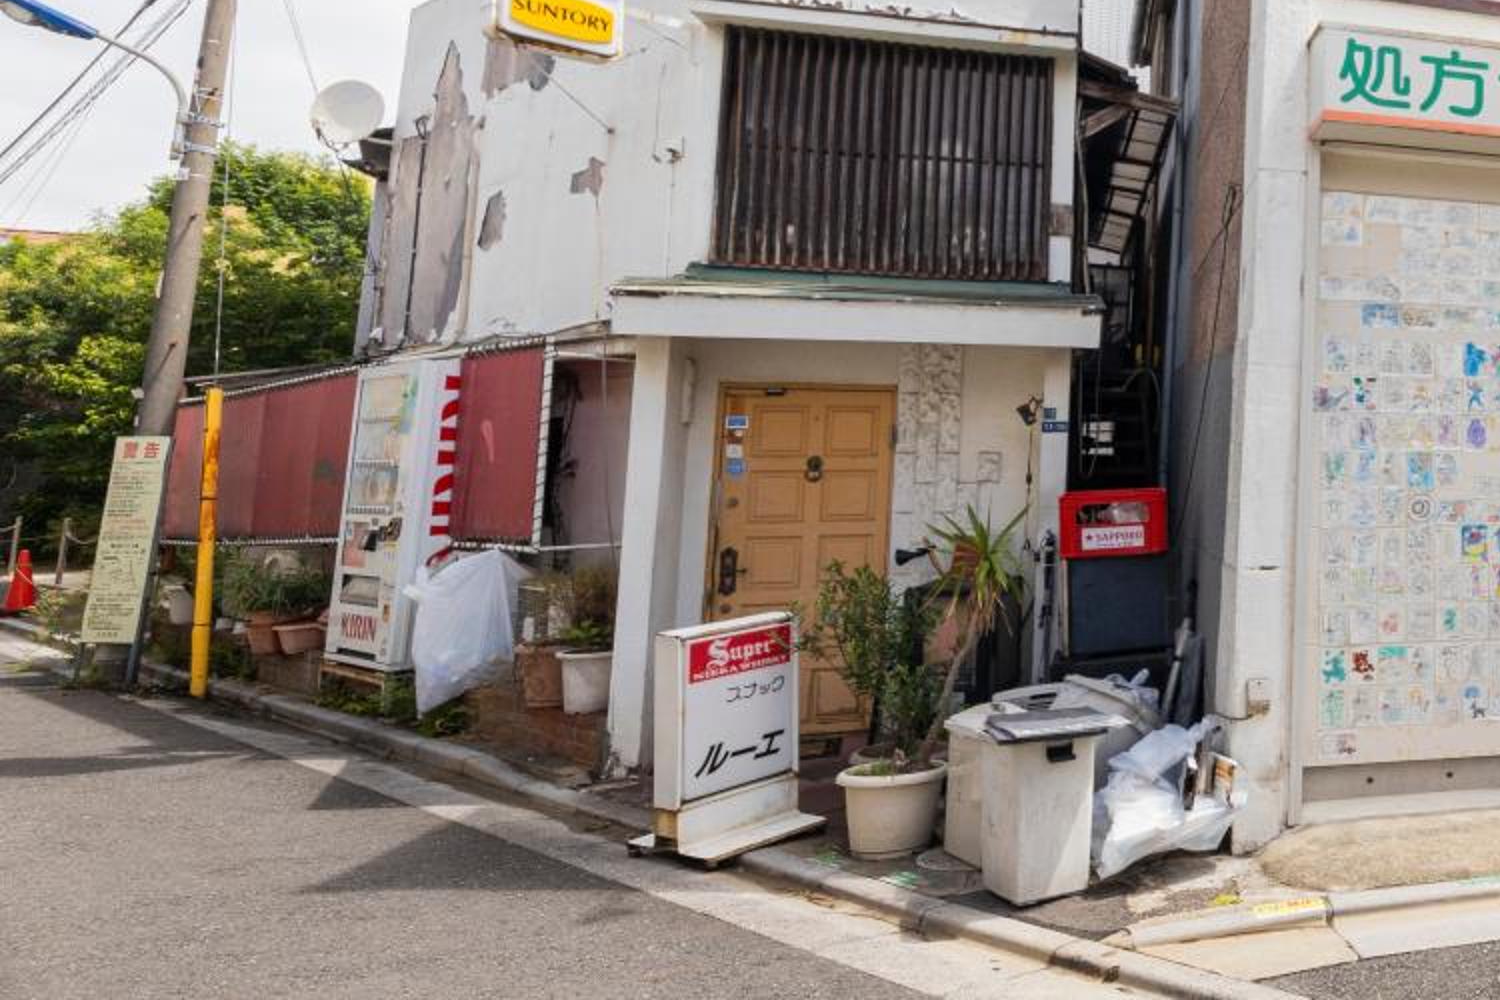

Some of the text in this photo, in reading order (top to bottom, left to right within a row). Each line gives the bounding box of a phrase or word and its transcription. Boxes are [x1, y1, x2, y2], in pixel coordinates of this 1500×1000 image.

[341, 611, 378, 642] KIRIN
[725, 674, 785, 704] スナック
[694, 728, 786, 779] ルーエ
